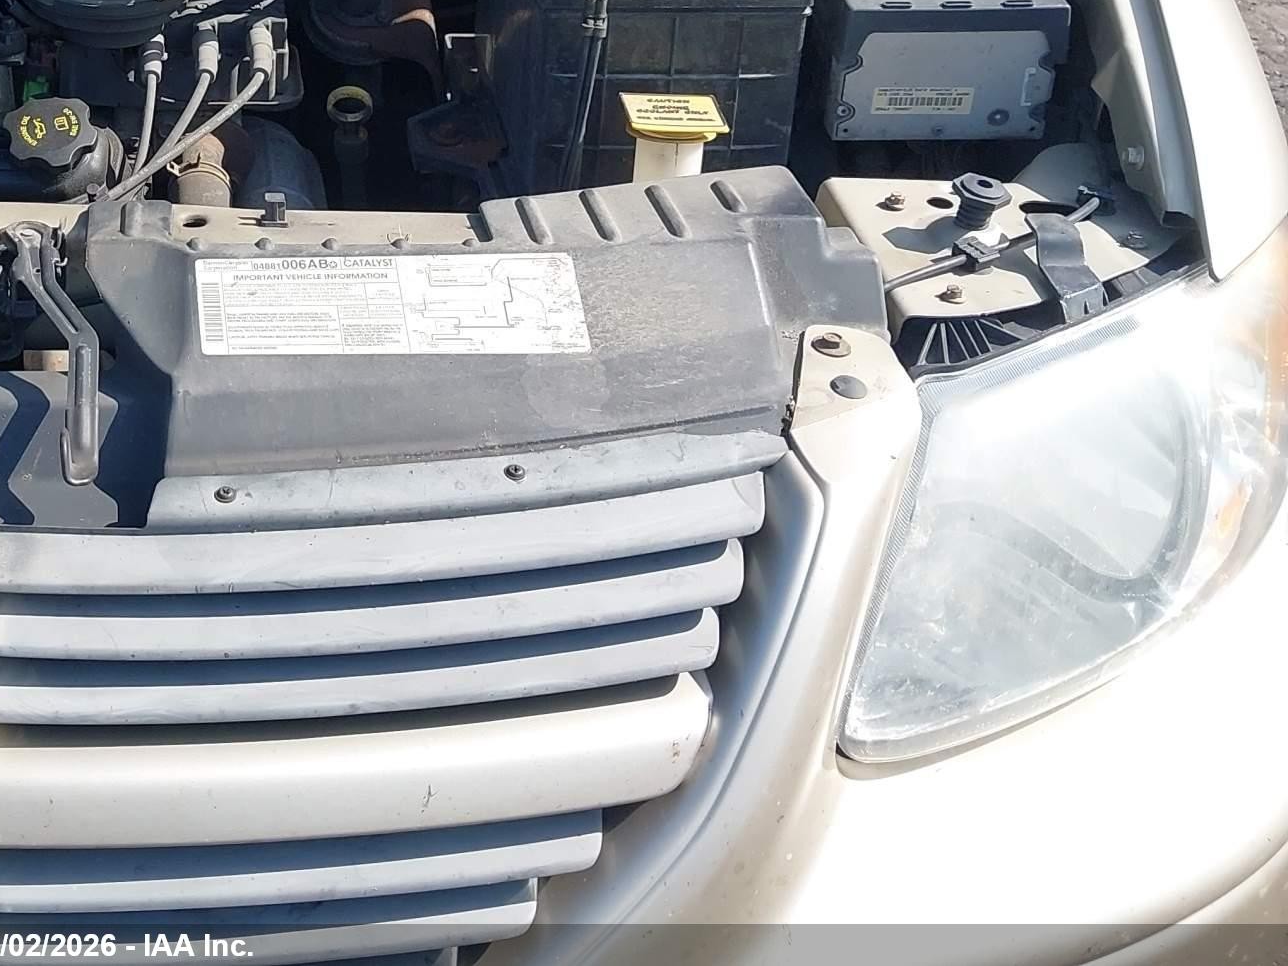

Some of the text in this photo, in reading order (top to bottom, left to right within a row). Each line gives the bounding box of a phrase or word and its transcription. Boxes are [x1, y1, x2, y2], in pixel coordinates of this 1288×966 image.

[343, 258, 394, 267] CATALYST
[233, 273, 284, 281] IMPORTANT
[324, 272, 388, 280] INFORMATION
